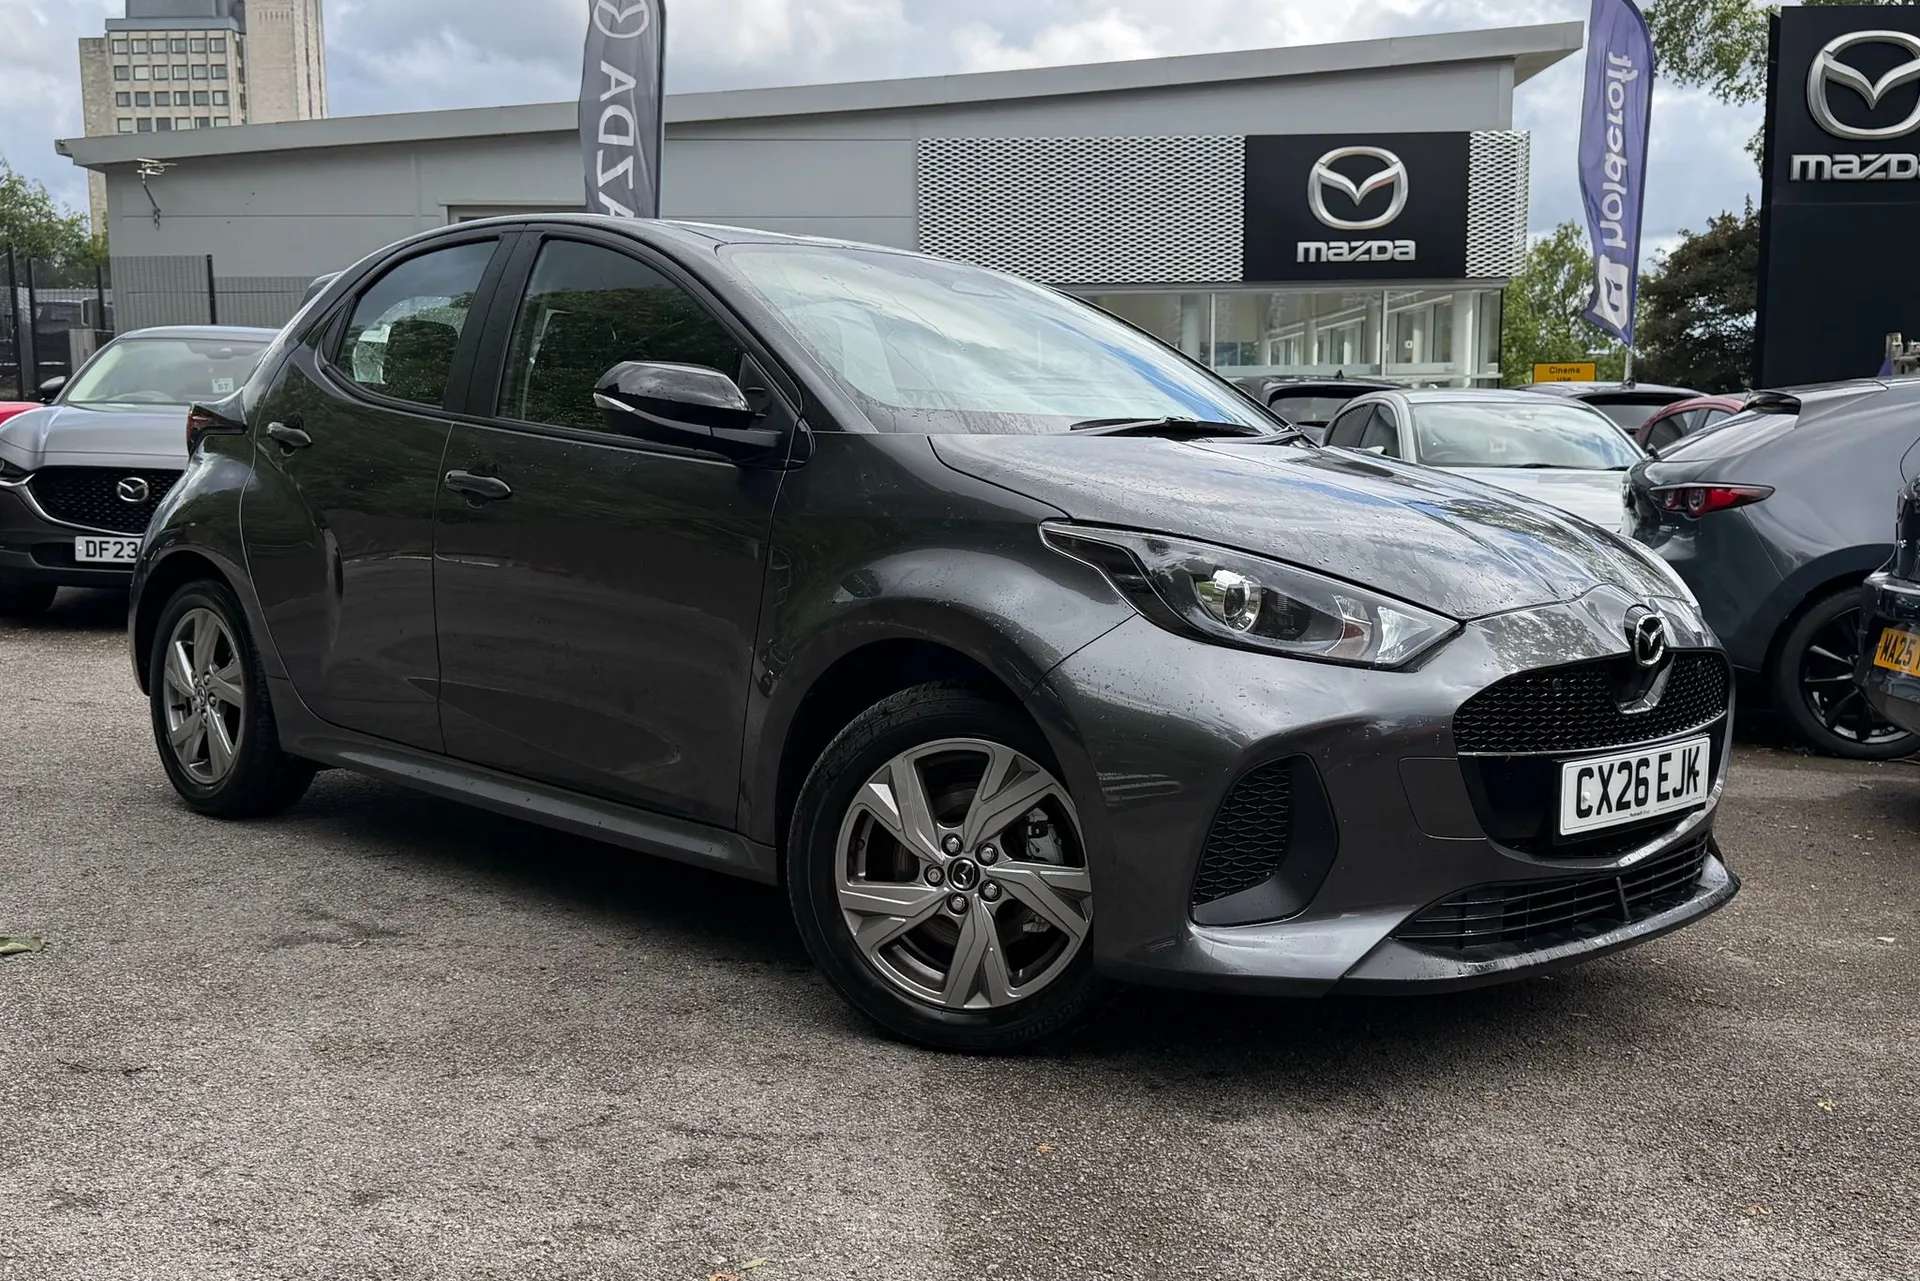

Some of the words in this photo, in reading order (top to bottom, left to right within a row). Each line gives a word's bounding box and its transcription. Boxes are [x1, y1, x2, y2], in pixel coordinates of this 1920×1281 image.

[1549, 366, 1581, 375] Cinema
[85, 540, 138, 559] DF23
[1576, 758, 1650, 819] CX26
[1656, 746, 1700, 803] EJK
